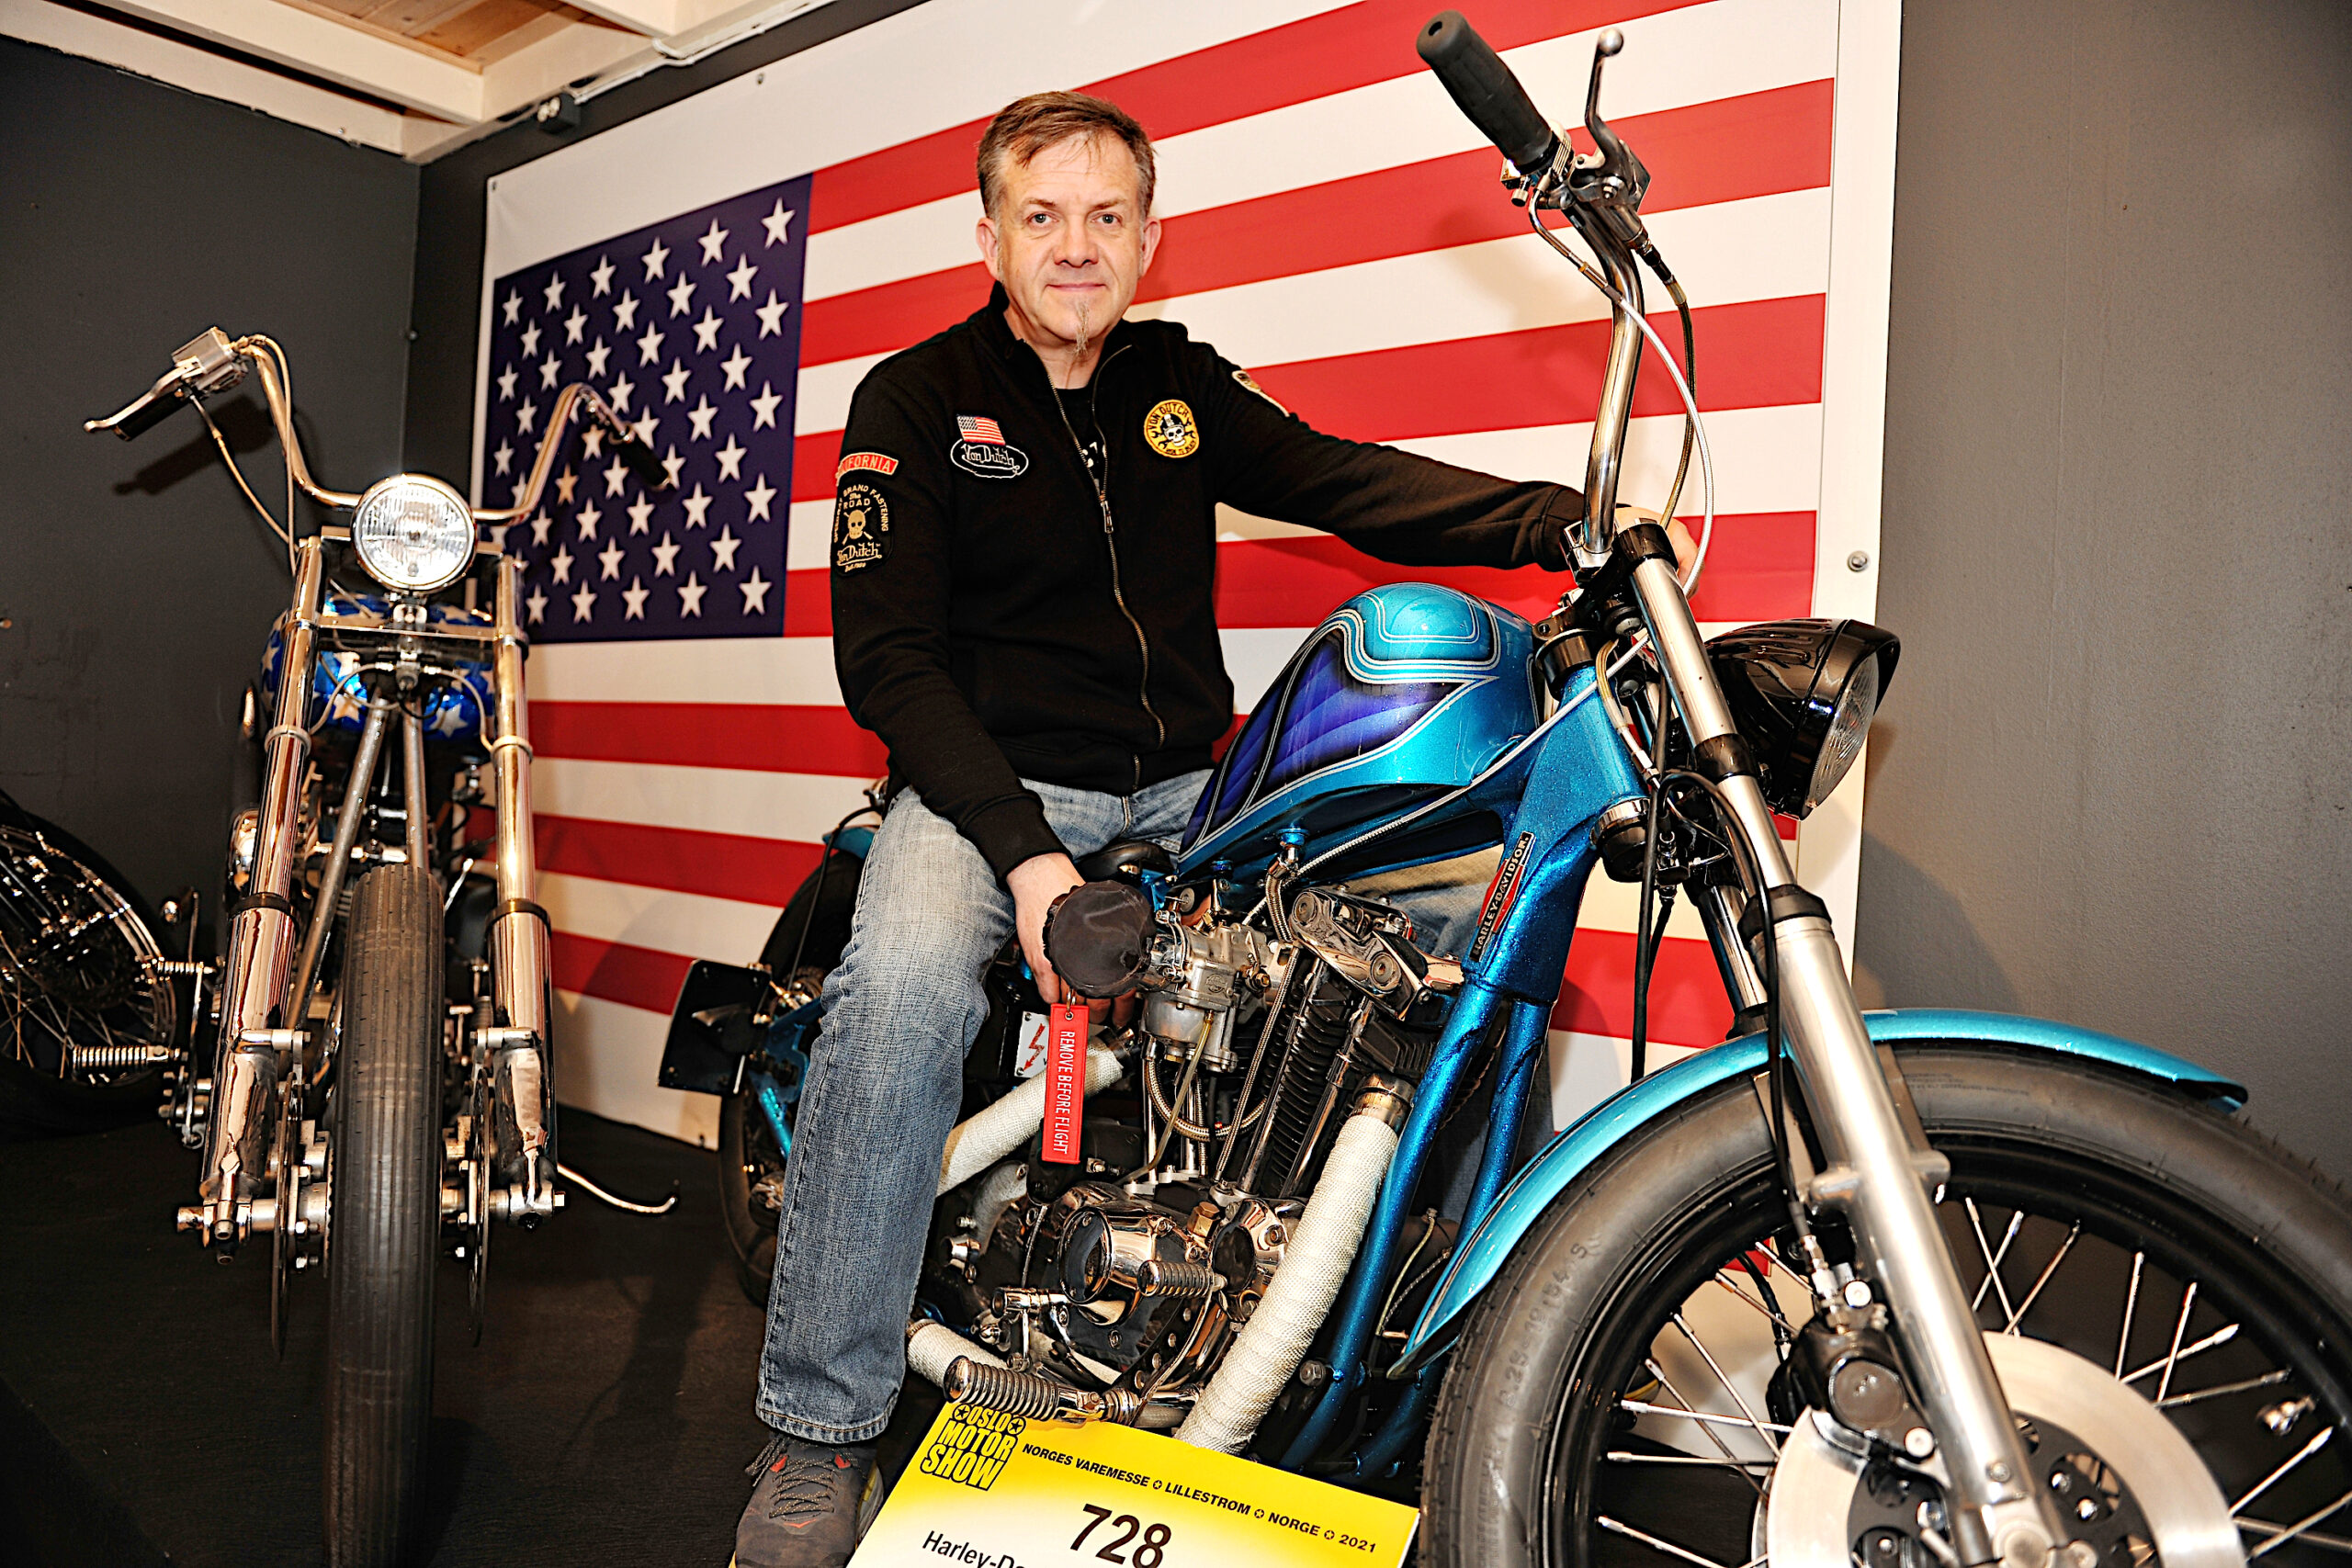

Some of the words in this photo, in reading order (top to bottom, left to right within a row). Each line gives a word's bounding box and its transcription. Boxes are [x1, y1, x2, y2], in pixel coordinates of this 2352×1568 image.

[1148, 413, 1160, 430] VON
[1159, 403, 1189, 418] DUTCH
[960, 444, 983, 463] Von
[977, 445, 1020, 470] Dutch
[843, 498, 871, 510] ROAD
[869, 489, 888, 532] FASTENING
[844, 542, 882, 559] Dutch
[1057, 1031, 1075, 1073] REMOVE
[1055, 1074, 1073, 1114] BEFORE
[1053, 1116, 1070, 1155] FLIGHT
[965, 1404, 1012, 1433] OSLO
[935, 1418, 1018, 1462] MOTOR
[920, 1442, 1006, 1491] SHOW
[1022, 1443, 1074, 1466] NORGES
[1075, 1457, 1151, 1487] VAREMESSE
[1164, 1482, 1251, 1517] LILLESTRØM
[1267, 1512, 1321, 1537] NORGE
[1338, 1534, 1377, 1553] 2021
[922, 1529, 1025, 1568] Harley-D
[1069, 1503, 1172, 1568] 728
